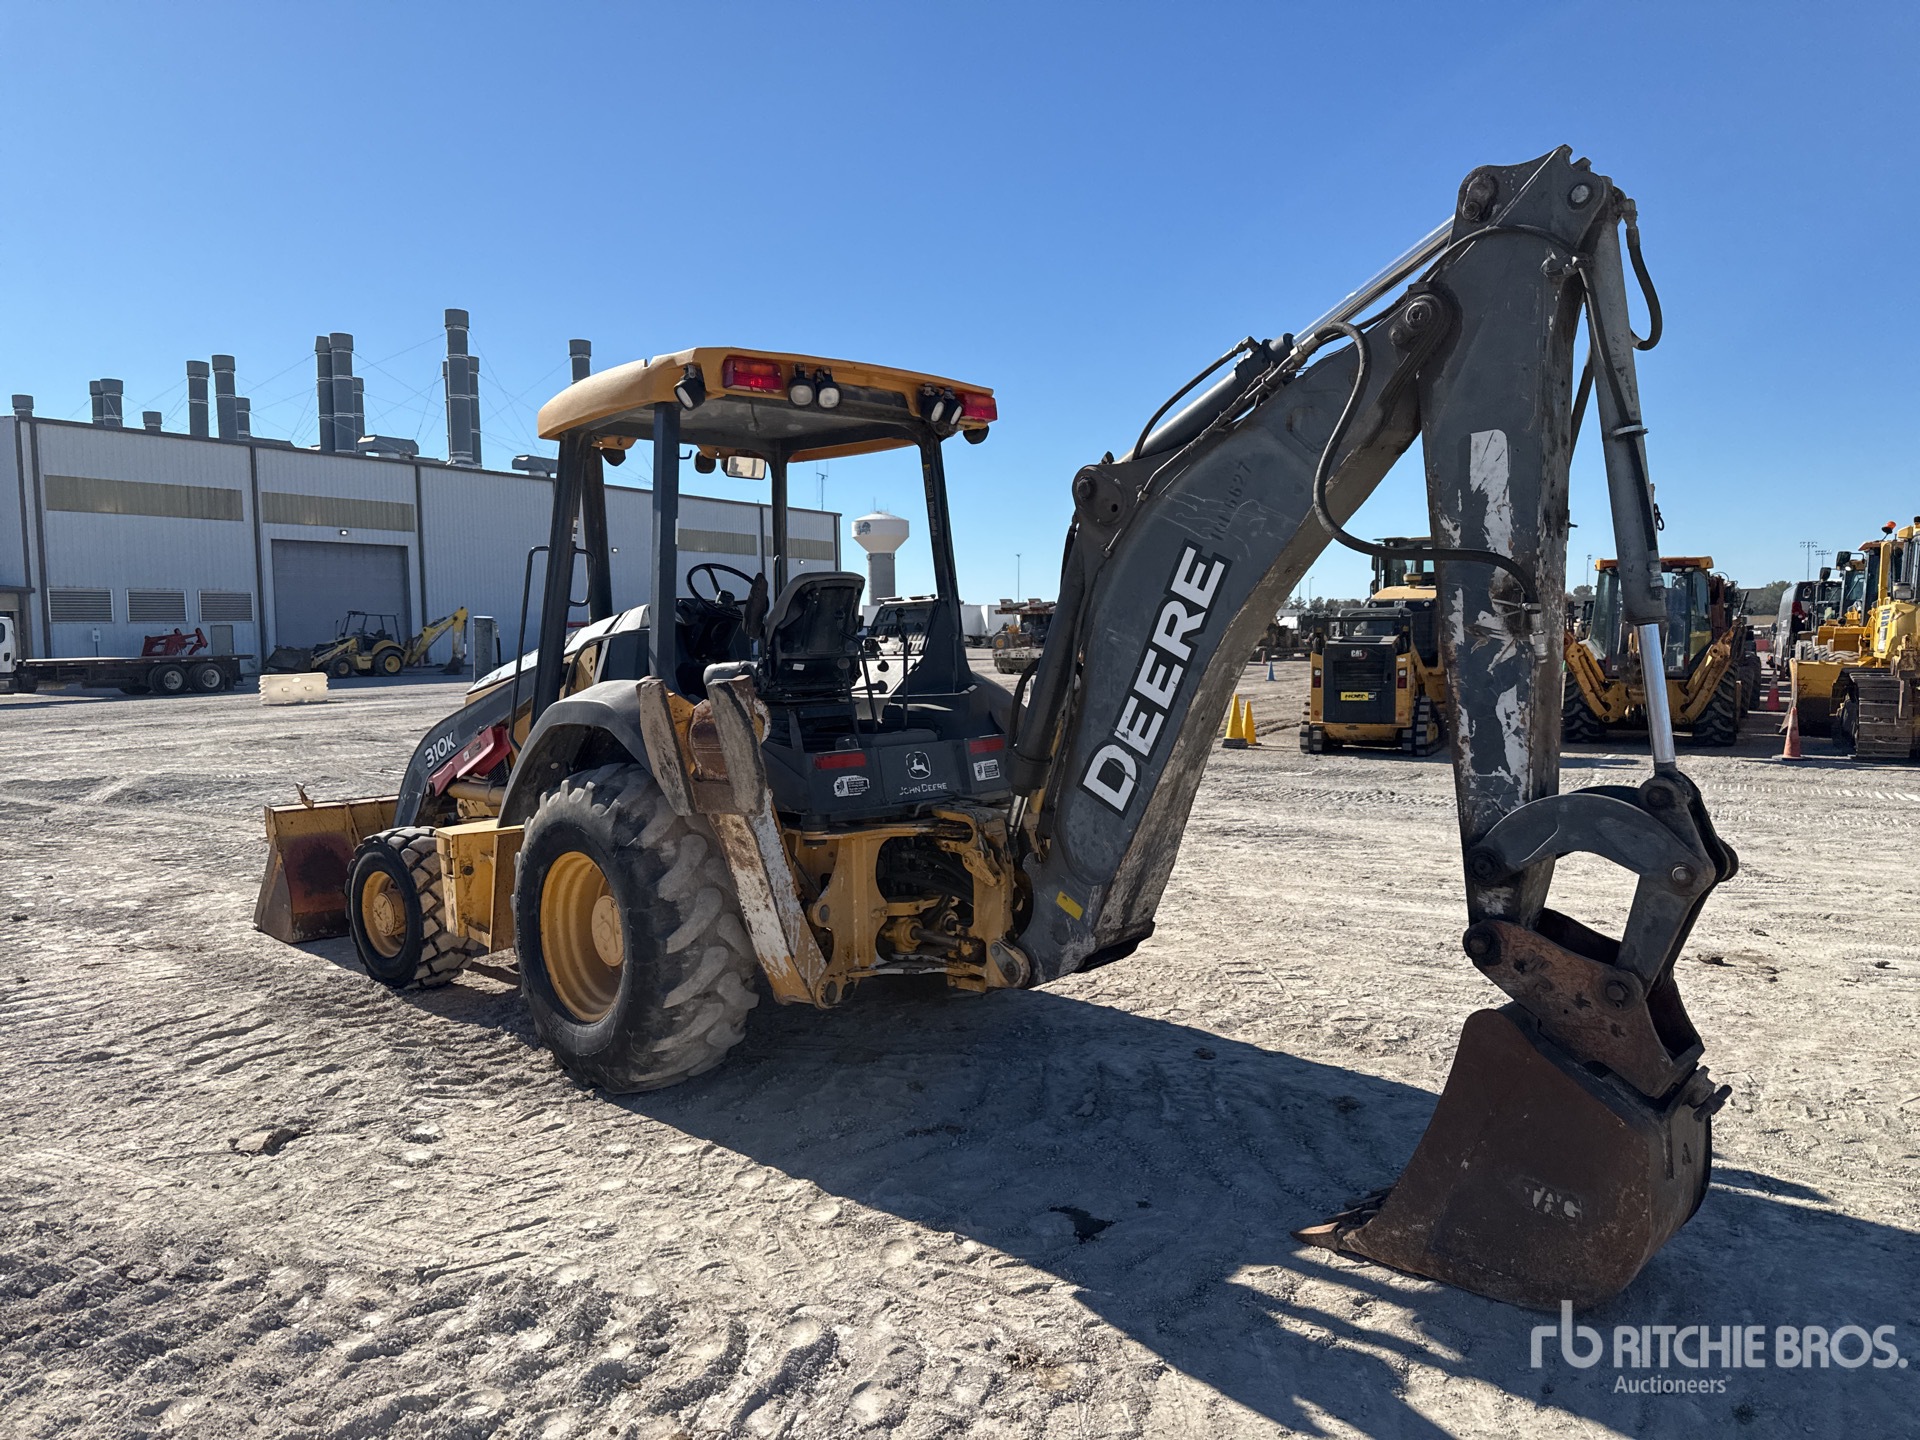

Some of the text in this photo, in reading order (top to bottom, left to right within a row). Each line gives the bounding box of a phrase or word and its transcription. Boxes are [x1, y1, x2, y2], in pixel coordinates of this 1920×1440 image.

[1394, 600, 1407, 608] CAT
[1350, 649, 1363, 658] CAT
[1082, 545, 1226, 812] DEERE
[424, 731, 457, 769] 310K
[899, 782, 948, 796] JOHN DEERE
